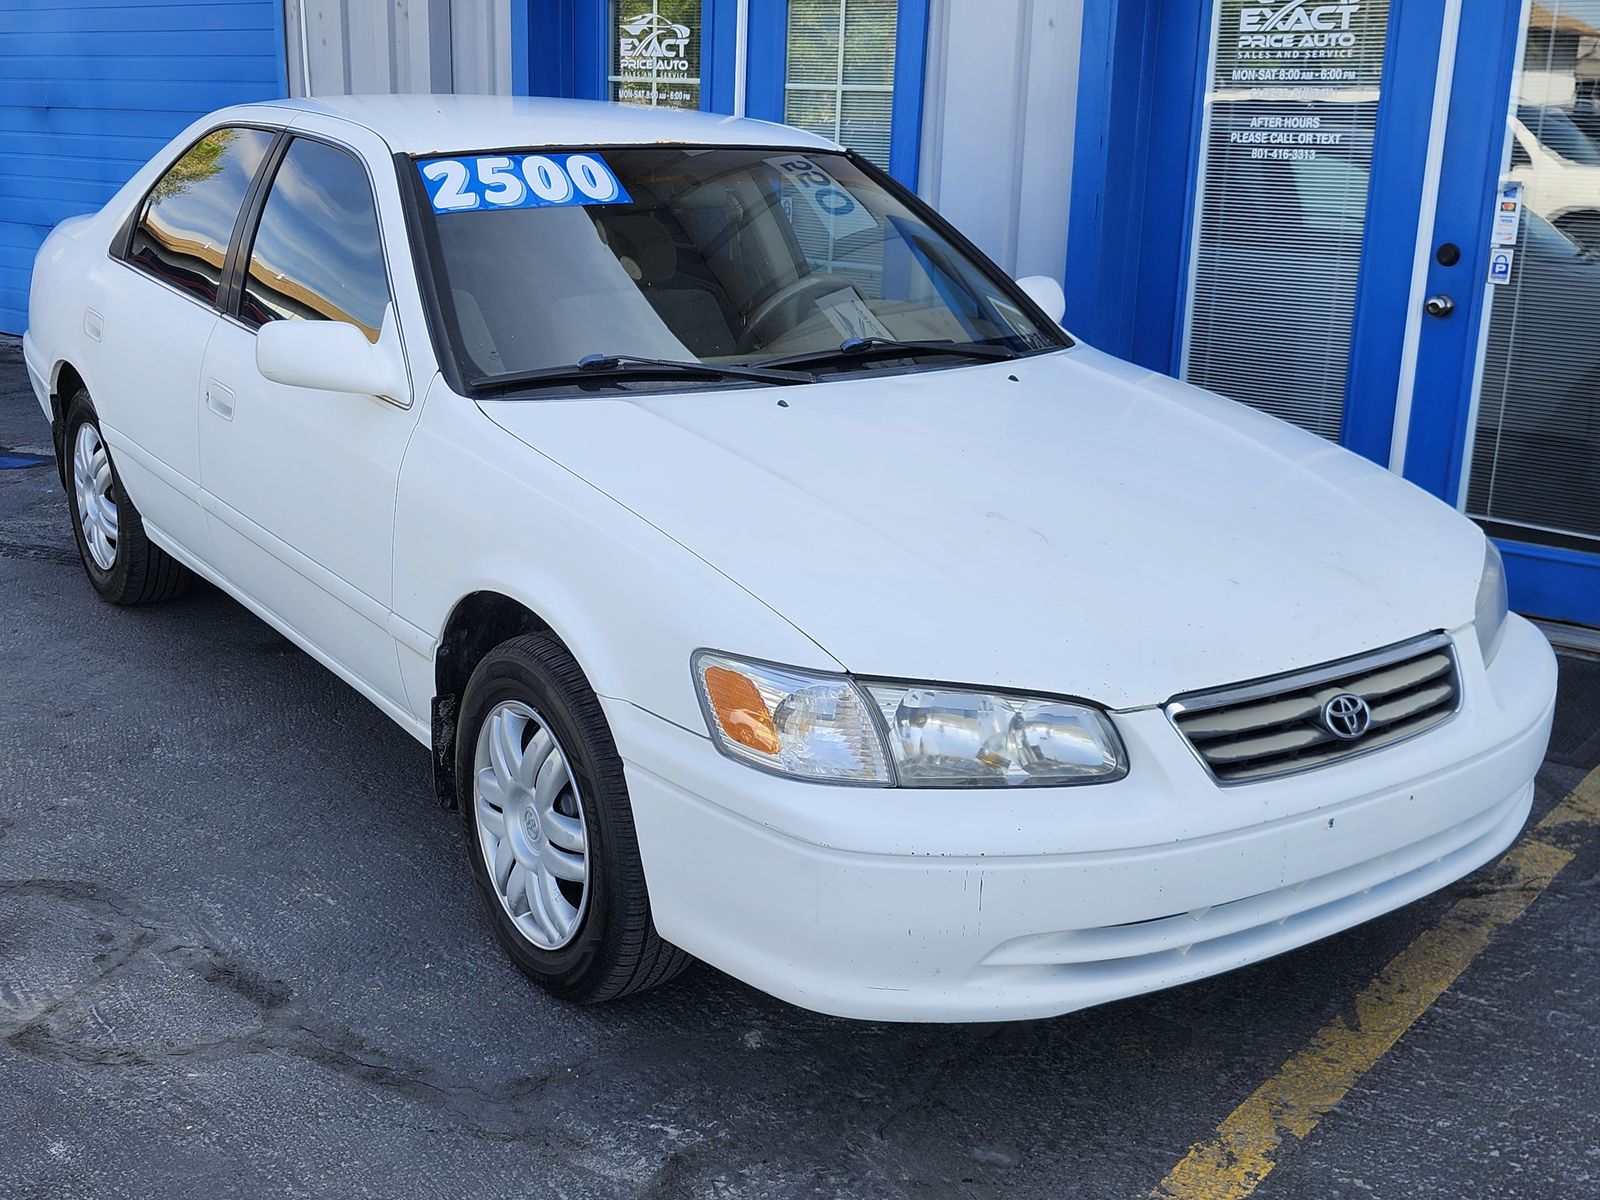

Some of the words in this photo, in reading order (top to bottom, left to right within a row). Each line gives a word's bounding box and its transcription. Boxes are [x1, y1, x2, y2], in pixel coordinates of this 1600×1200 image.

[1240, 5, 1360, 31] EXACT
[1238, 34, 1295, 48] PRICE
[1299, 33, 1356, 47] AUTO
[620, 38, 690, 58] EXACT
[1238, 51, 1270, 59] SALES
[1276, 50, 1299, 58] AND
[1305, 50, 1354, 58] SERVICE
[620, 60, 653, 70] PRICE
[656, 60, 689, 70] AUTO
[660, 71, 688, 79] SERVICE
[1232, 69, 1278, 80] MON-SAT
[1279, 69, 1300, 80] 8:00
[1301, 71, 1313, 80] AM
[1320, 69, 1342, 80] 6:00
[1343, 71, 1356, 79] PM
[659, 92, 666, 100] AM
[670, 91, 683, 100] 6:00
[1250, 117, 1281, 128] AFTER
[1284, 117, 1320, 128] HOURS
[1230, 132, 1267, 143] PLEASE
[1270, 132, 1295, 143] CALL
[1297, 133, 1314, 144] OR
[1316, 133, 1342, 144] TEXT
[422, 155, 619, 210] 2500
